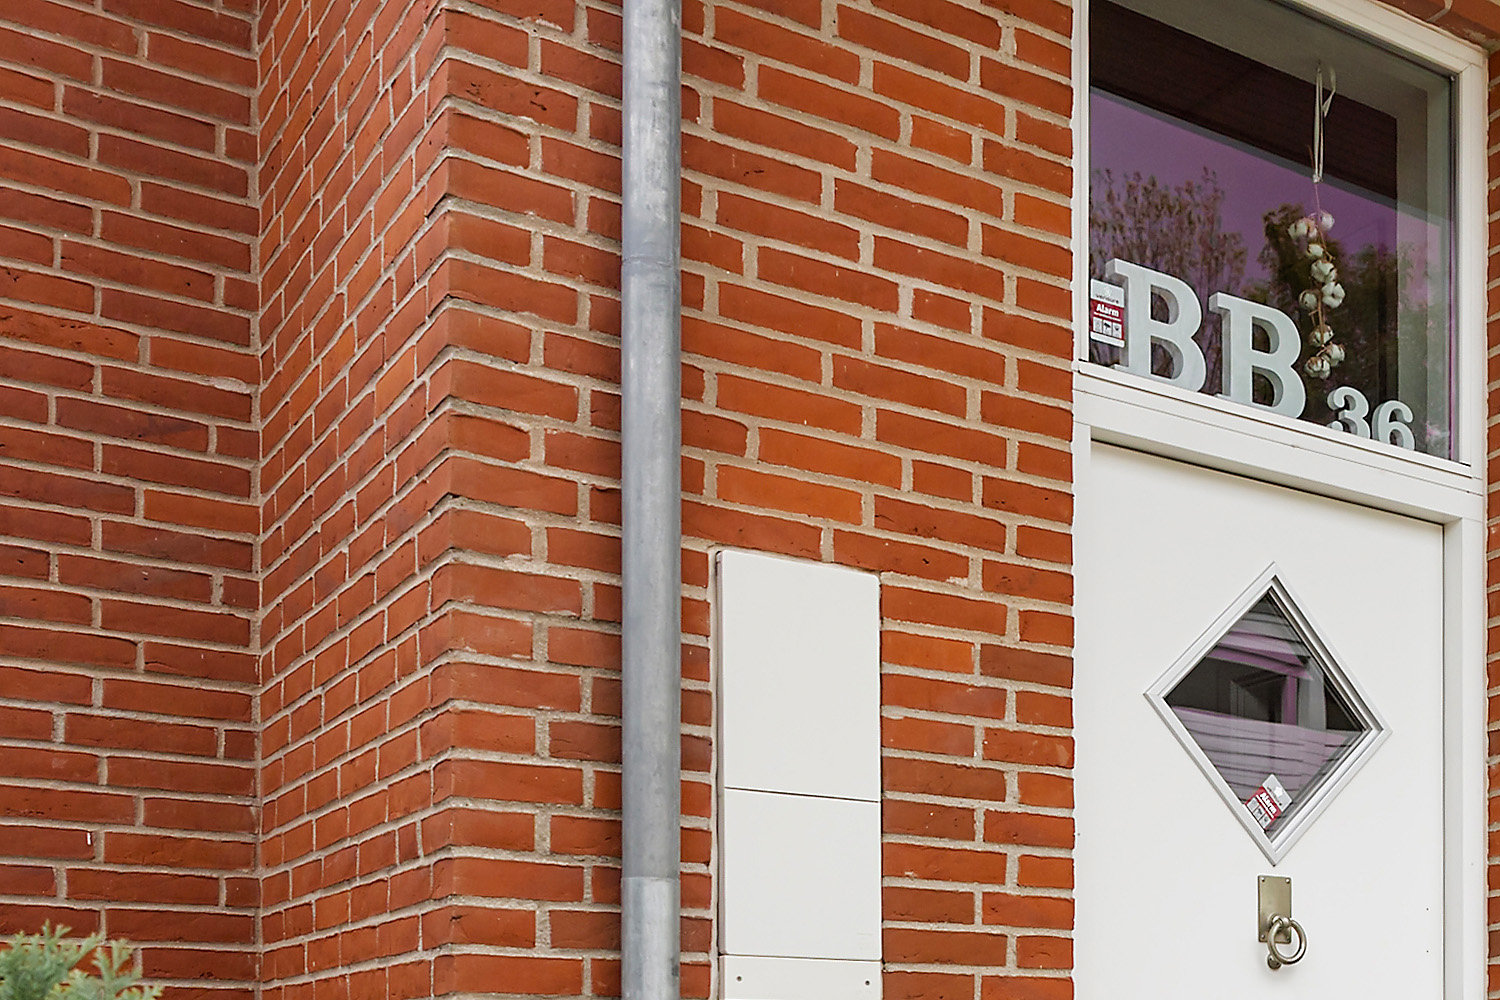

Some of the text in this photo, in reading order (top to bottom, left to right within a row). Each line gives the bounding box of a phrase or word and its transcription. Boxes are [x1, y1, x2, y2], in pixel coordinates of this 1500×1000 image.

[1096, 303, 1120, 318] Alarm
[1105, 258, 1307, 420] BB
[1326, 386, 1416, 451] 36
[1259, 792, 1278, 815] Alarm
